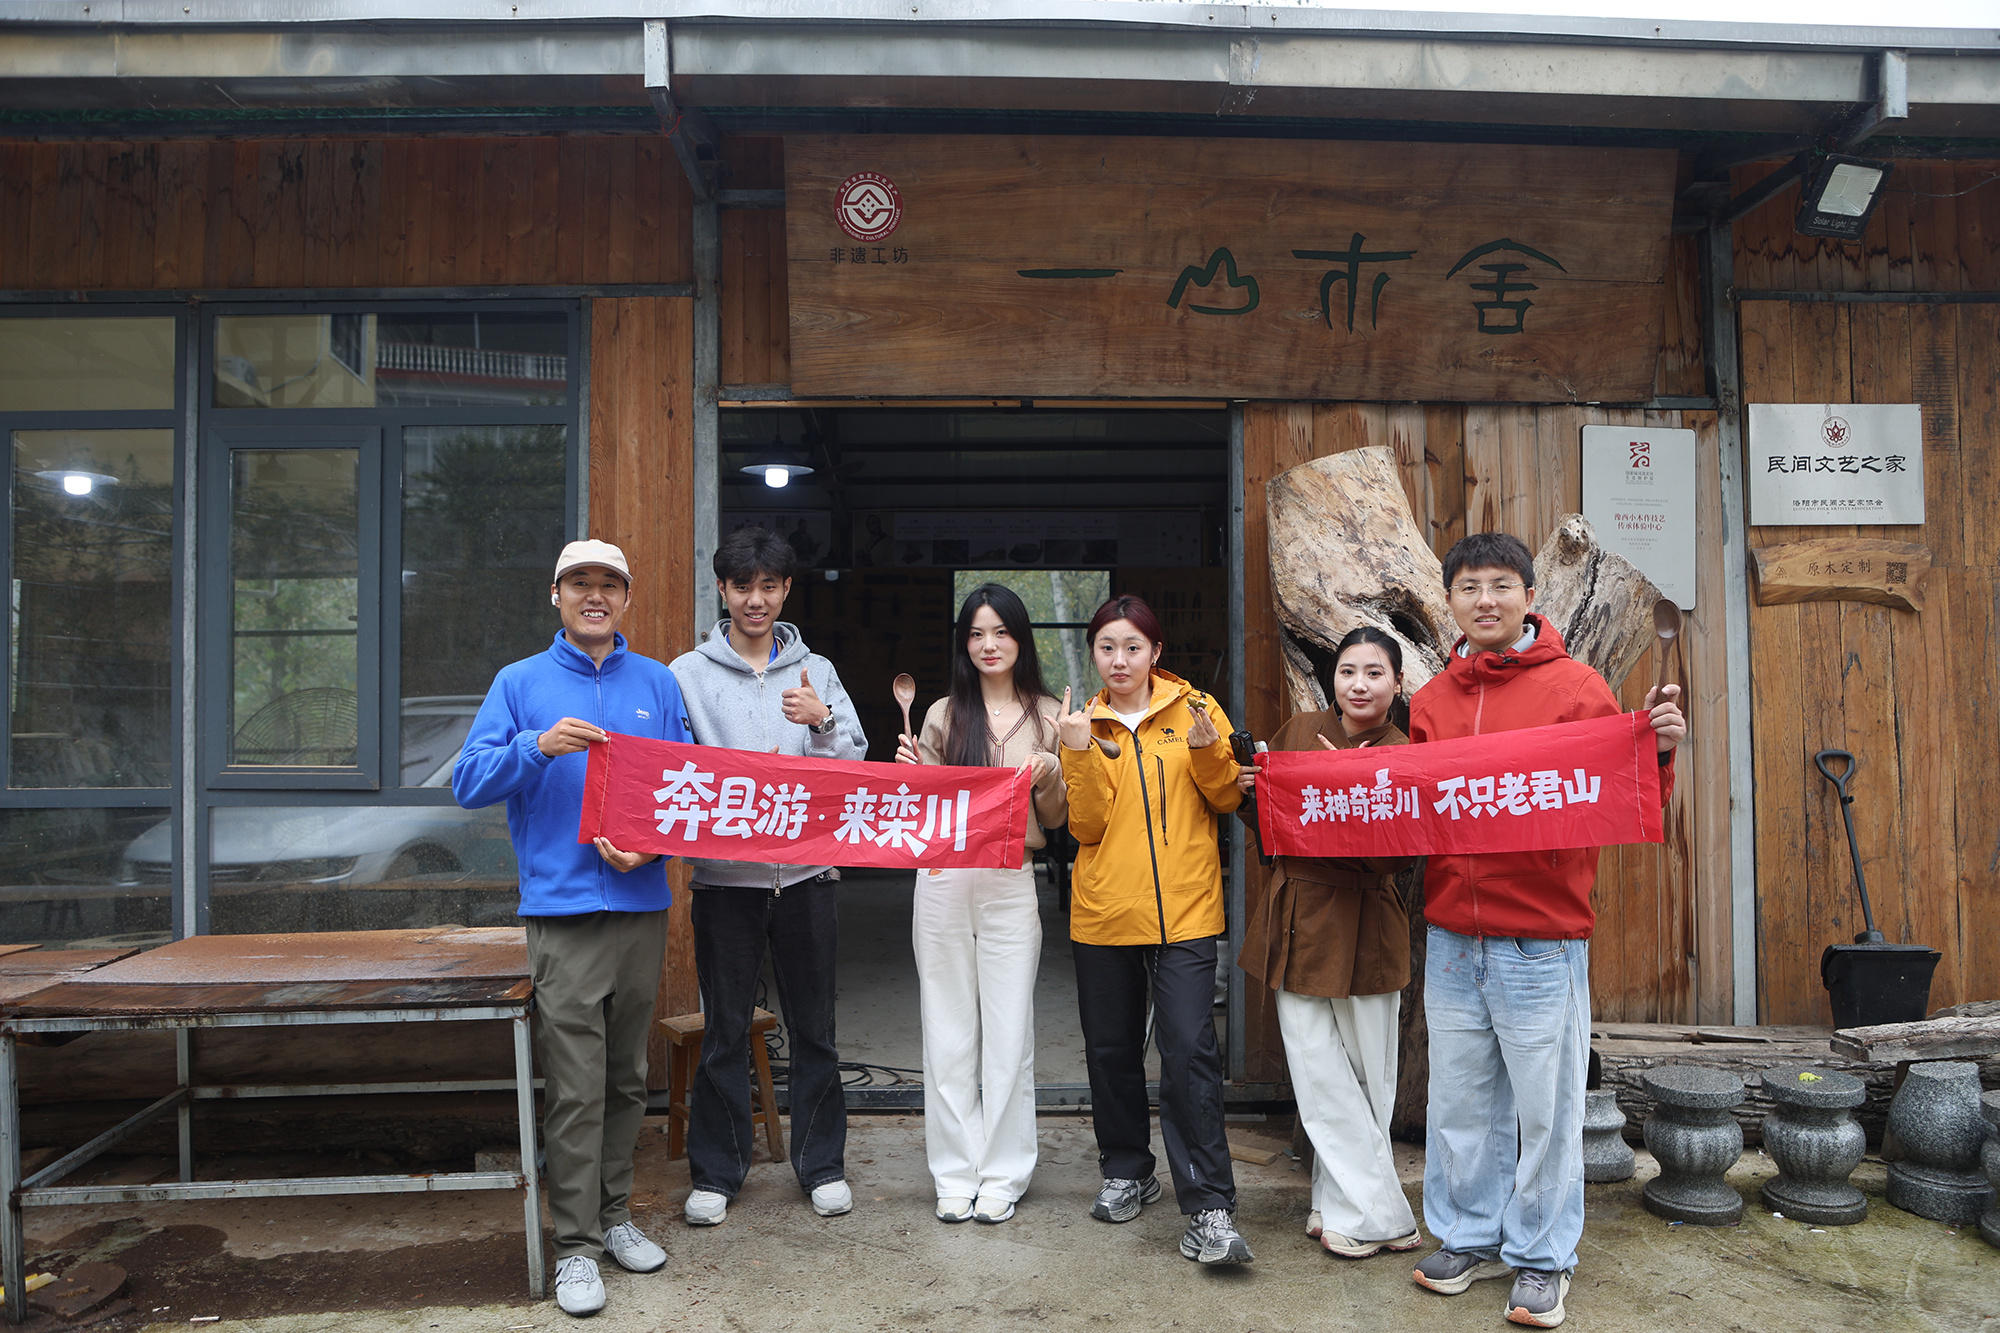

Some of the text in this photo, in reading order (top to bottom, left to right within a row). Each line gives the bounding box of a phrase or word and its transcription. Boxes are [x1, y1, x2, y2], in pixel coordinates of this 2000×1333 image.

[1813, 216, 1830, 226] Solar
[1831, 218, 1847, 229] Light
[830, 246, 908, 265] 非遗工坊
[1767, 454, 1906, 474] 民间文艺之家
[1806, 559, 1872, 576] 原木定制
[1157, 736, 1185, 746] CAMEL
[1299, 768, 1602, 827] 来神奇栾川 不只老君山
